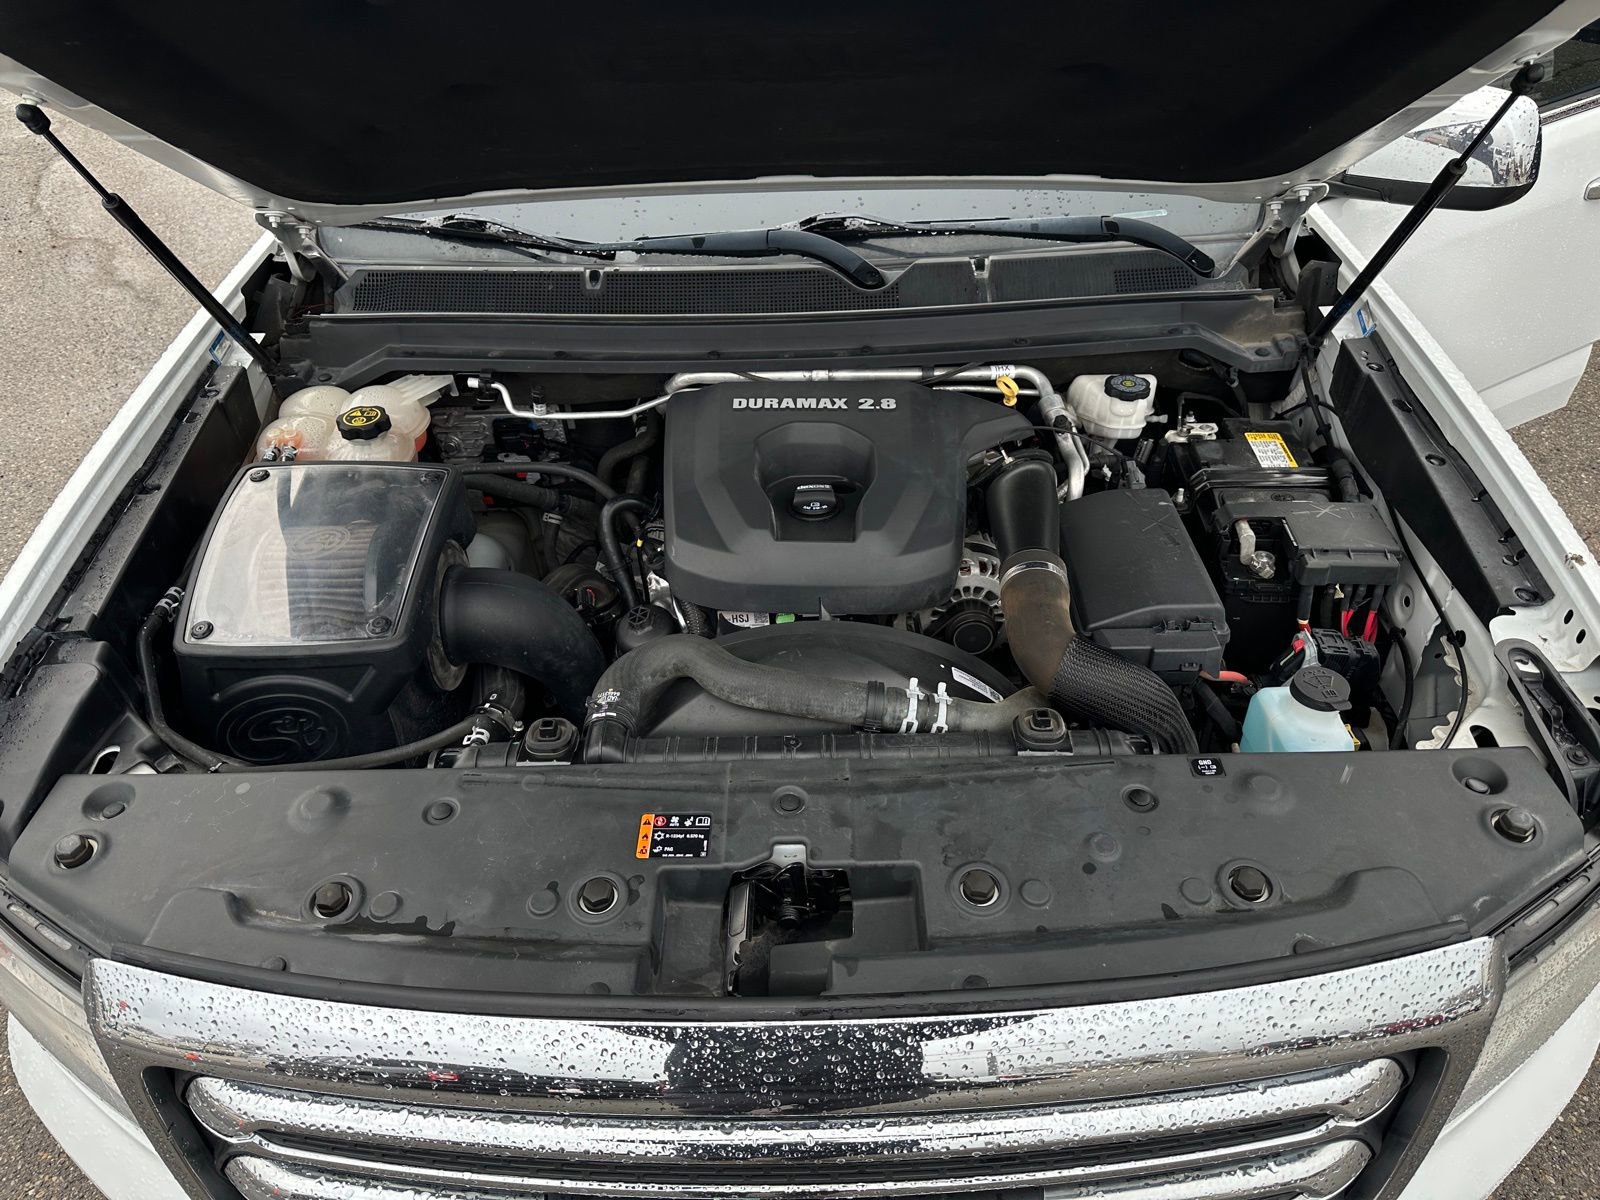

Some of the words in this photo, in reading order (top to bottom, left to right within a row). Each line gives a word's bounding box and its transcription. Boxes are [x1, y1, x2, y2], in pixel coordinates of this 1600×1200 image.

[732, 397, 849, 410] DURAMAX
[858, 397, 897, 410] 2.8
[731, 613, 750, 623] HSJ
